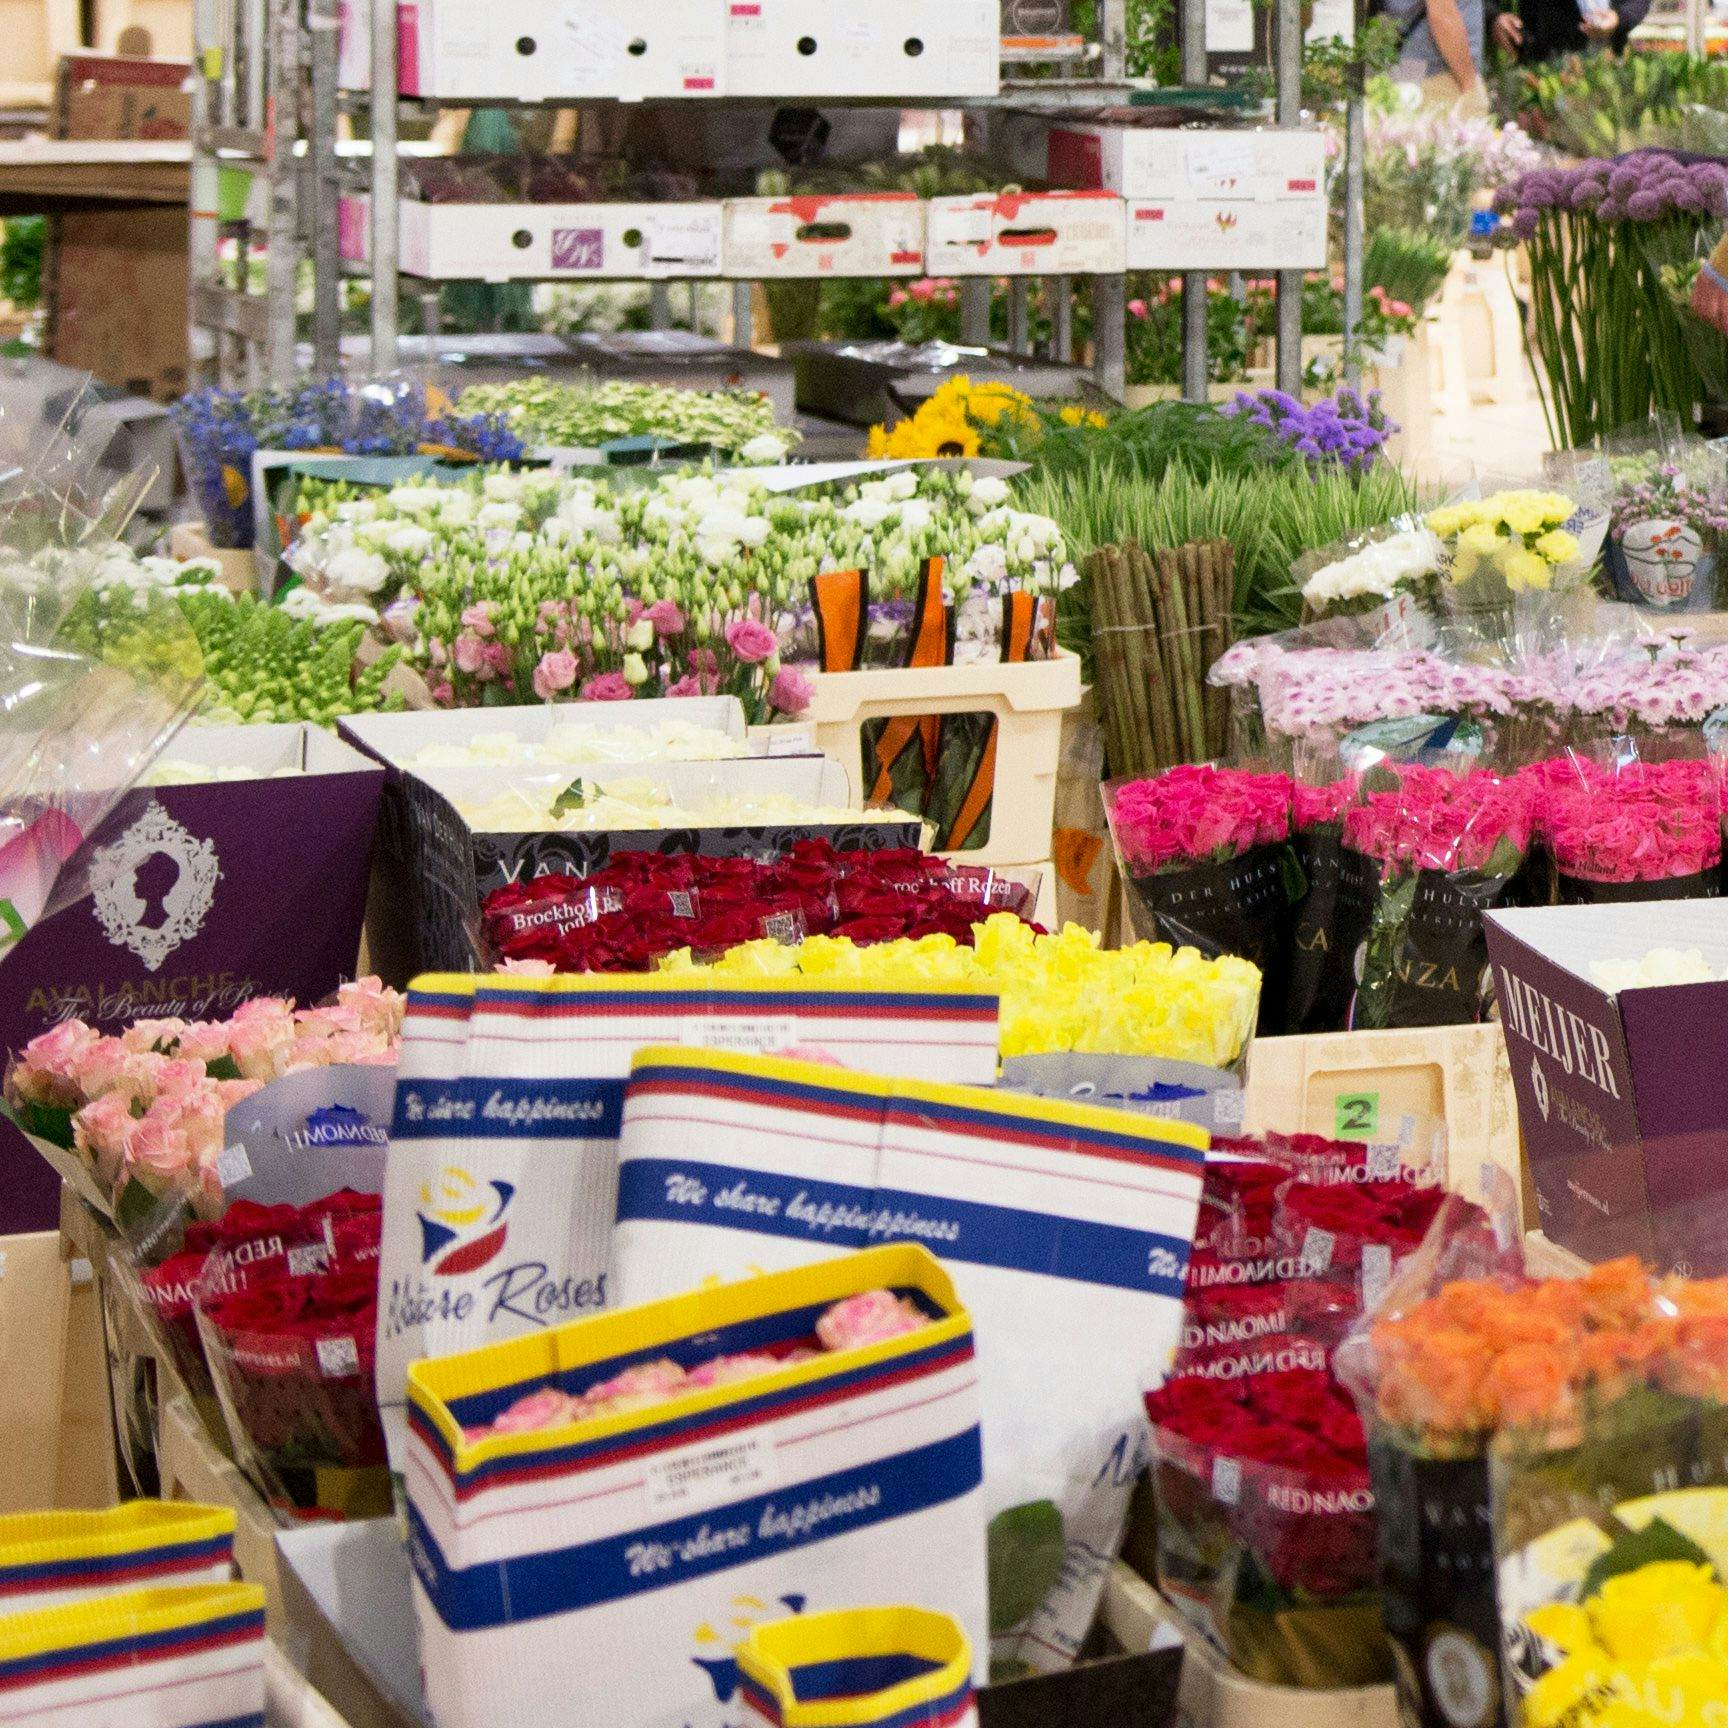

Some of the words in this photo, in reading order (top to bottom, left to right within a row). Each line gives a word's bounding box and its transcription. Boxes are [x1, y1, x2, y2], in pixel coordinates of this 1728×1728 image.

[1500, 965, 1621, 1101] MEIJER
[1342, 1100, 1374, 1130] 2
[483, 1260, 609, 1328] Roses
[757, 1484, 881, 1542] happiness
